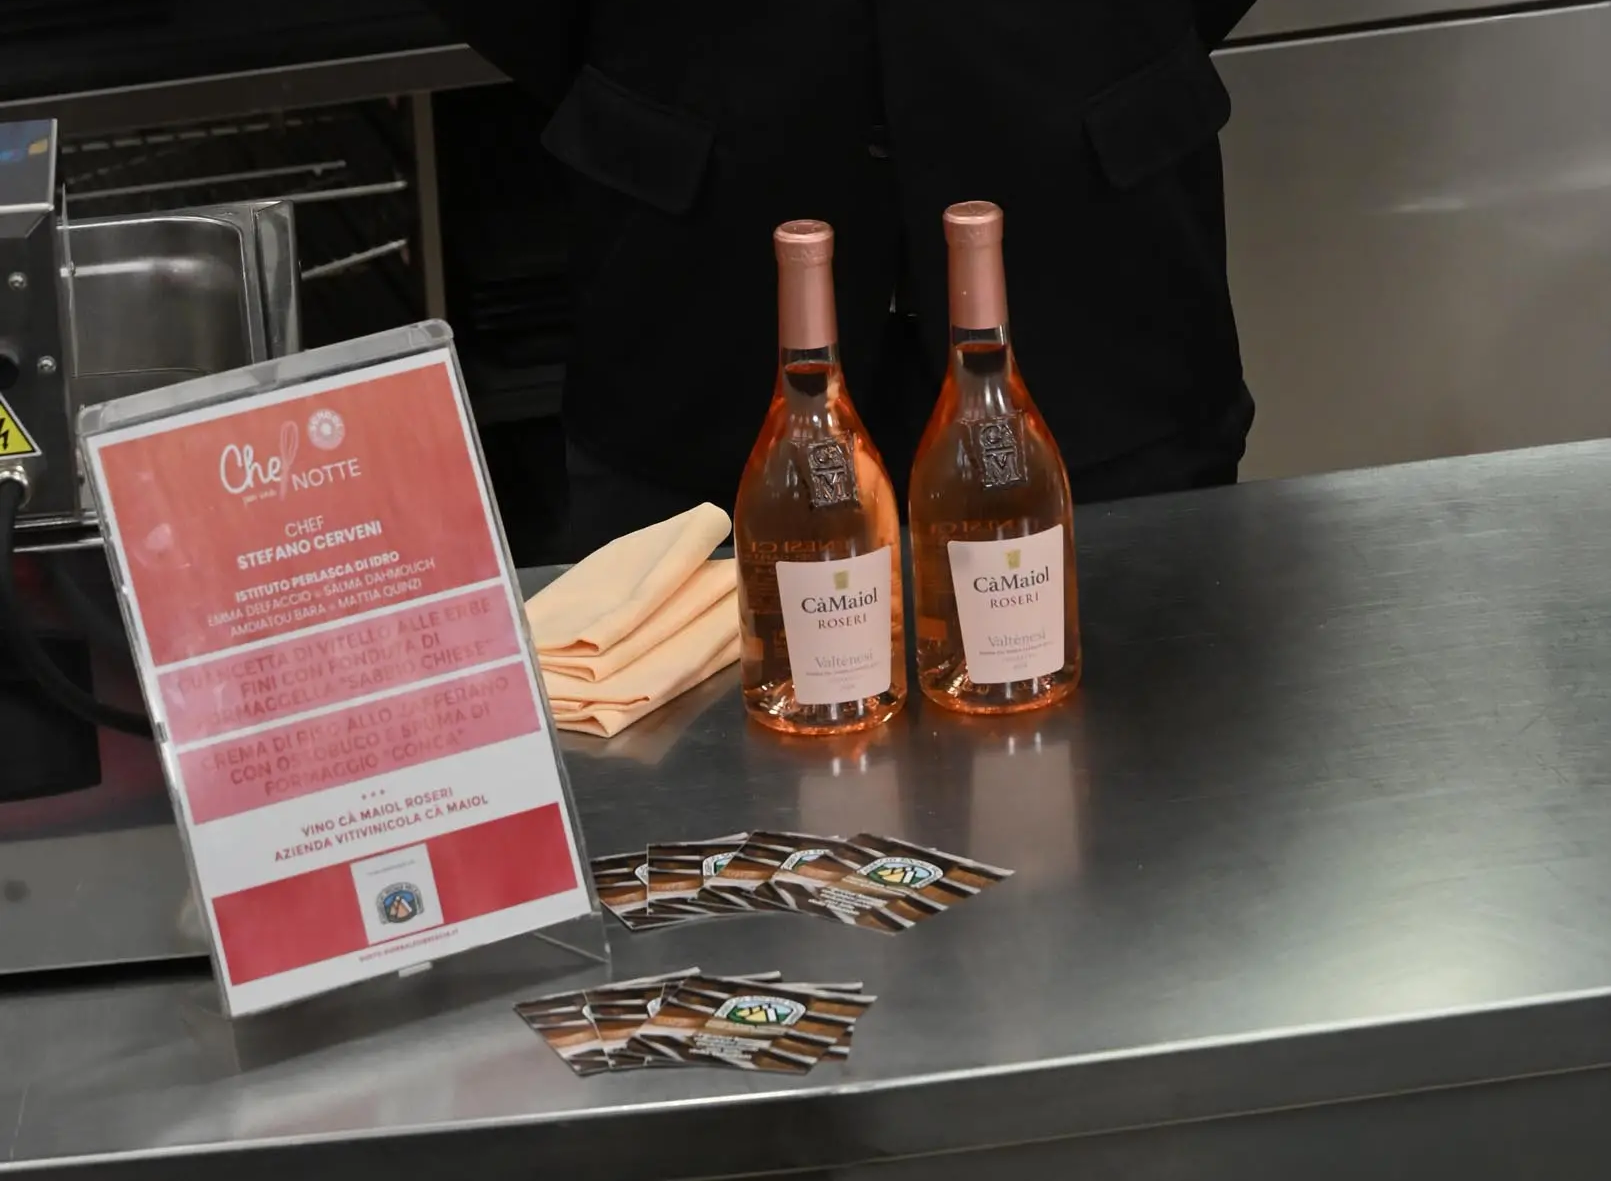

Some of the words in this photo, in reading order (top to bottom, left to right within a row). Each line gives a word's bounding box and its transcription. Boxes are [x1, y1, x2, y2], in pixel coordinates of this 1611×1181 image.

[292, 458, 361, 491] NOTTE
[237, 539, 311, 570] STEFANO
[314, 520, 383, 550] CERVENI
[285, 515, 324, 538] CHEF
[235, 579, 290, 603] ISTITUTO
[292, 563, 353, 589] PERLASCA
[355, 558, 369, 572] DI
[369, 551, 400, 568] IDRO
[801, 587, 879, 614] CàMaiol
[973, 566, 1050, 594] CàMaiol
[990, 591, 1040, 609] ROSERI
[208, 609, 243, 627] EMMA
[324, 578, 362, 597] SALMA
[295, 604, 327, 621] BARA
[338, 589, 382, 608] MATTIA
[818, 613, 868, 630] ROSERI
[293, 645, 313, 661] DI
[317, 625, 390, 655] VITELLO
[398, 611, 441, 634] ALLE
[240, 675, 277, 698] FINI
[282, 664, 323, 685] CON
[421, 632, 440, 649] DI
[201, 741, 267, 770] CREMA
[272, 733, 292, 752] DI
[348, 707, 392, 733] ALLO
[231, 761, 272, 784] CON
[471, 701, 490, 719] DI
[264, 752, 379, 796] FORMAGGIO
[274, 837, 333, 862] AZIENDA
[335, 813, 422, 846] VITIVINICOLA
[445, 794, 489, 814] MAIOL
[301, 819, 335, 837] VINO
[359, 803, 404, 822] MAIOL
[406, 786, 454, 809] ROSERI
